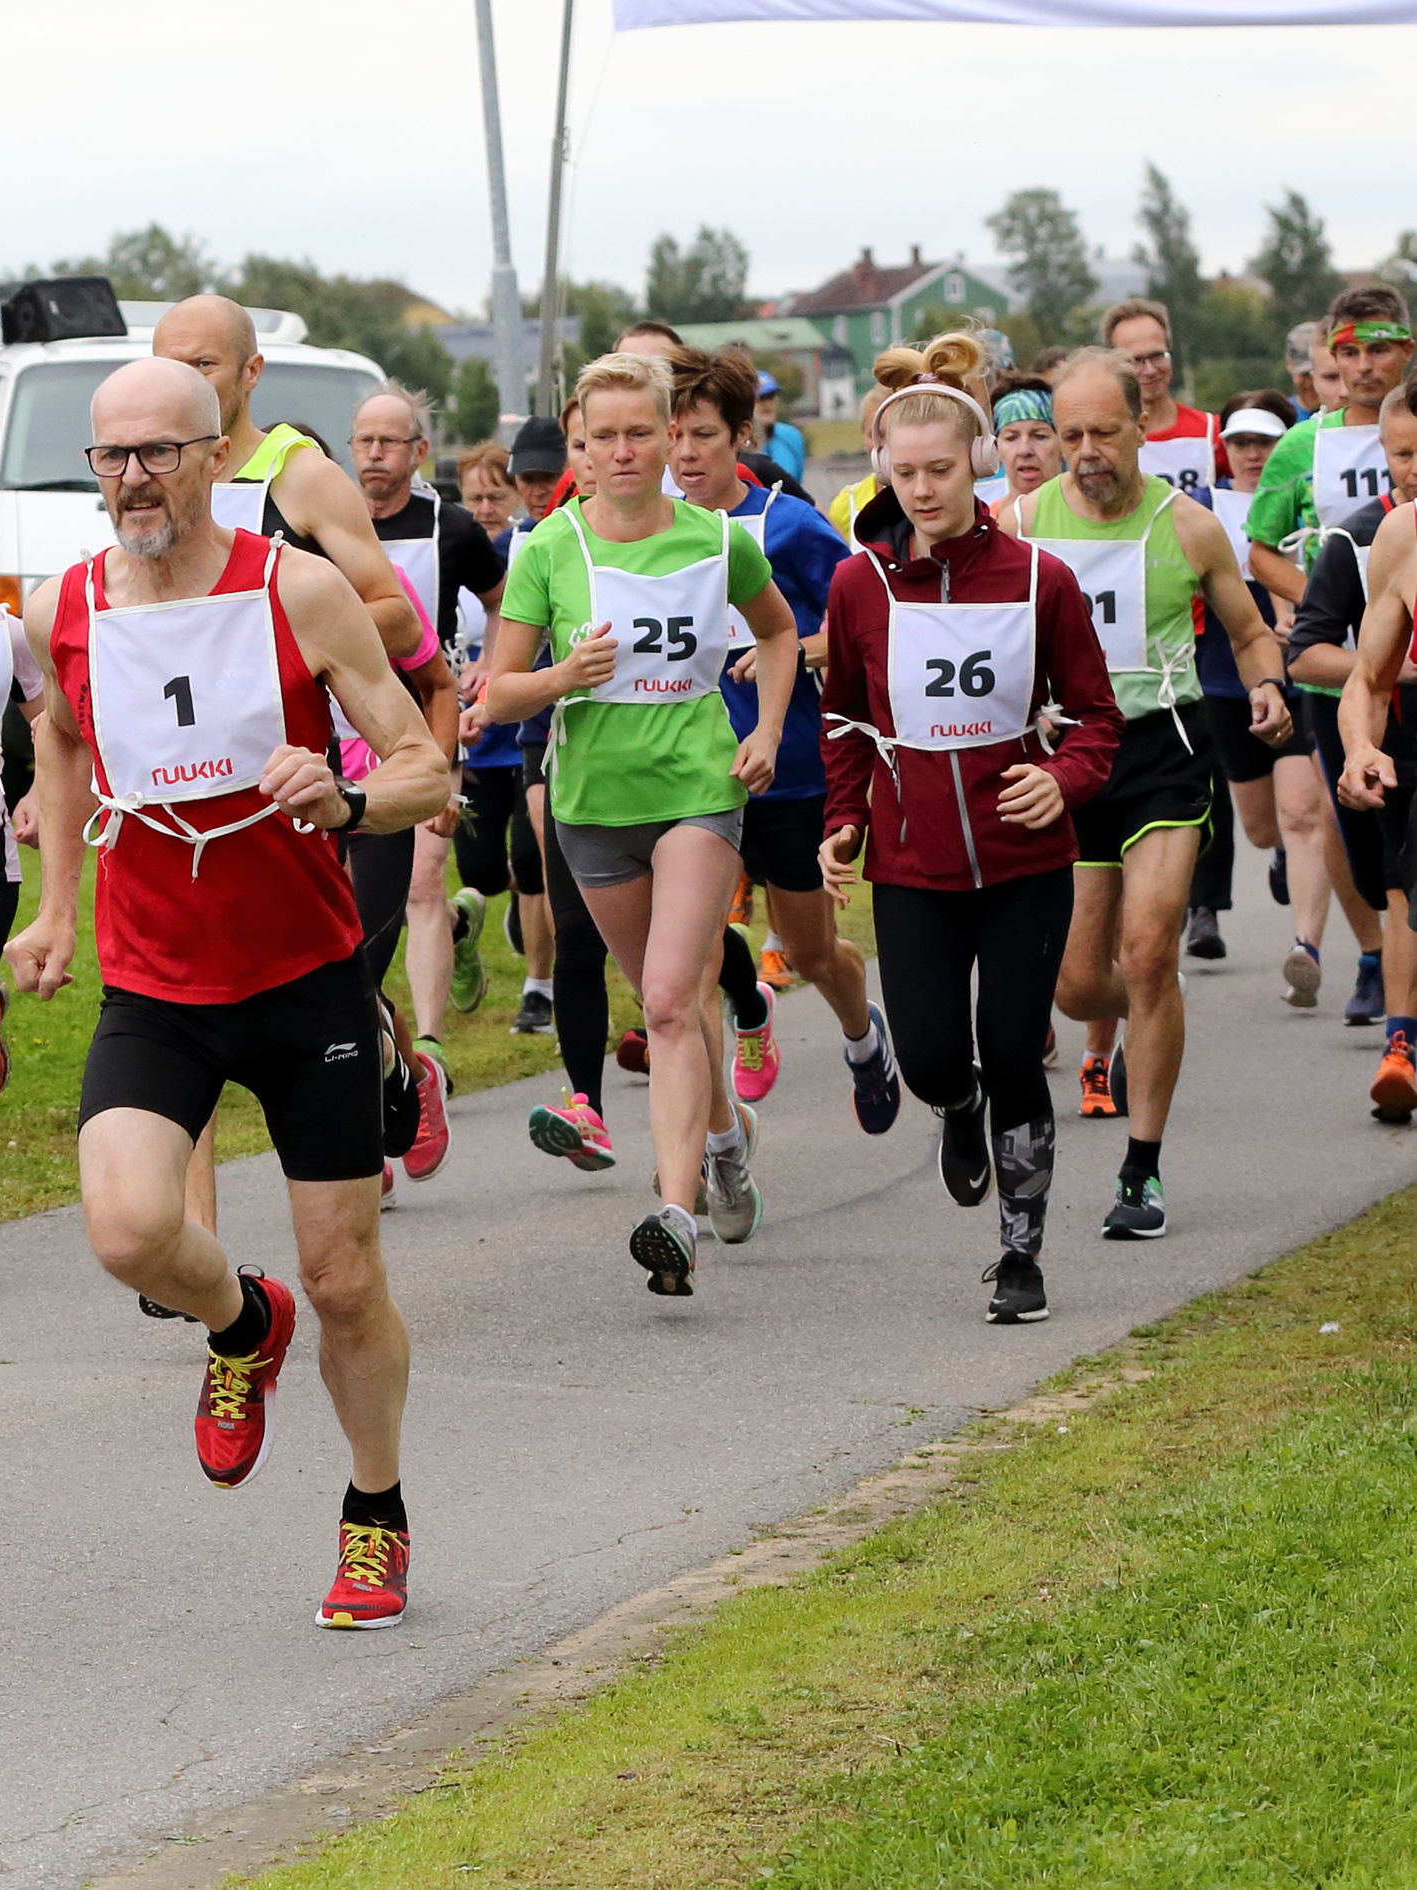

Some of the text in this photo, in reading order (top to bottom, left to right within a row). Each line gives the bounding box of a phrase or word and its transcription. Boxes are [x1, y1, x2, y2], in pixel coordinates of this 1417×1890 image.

[633, 616, 697, 662] 25
[925, 650, 995, 698] 26
[163, 675, 195, 727] 1
